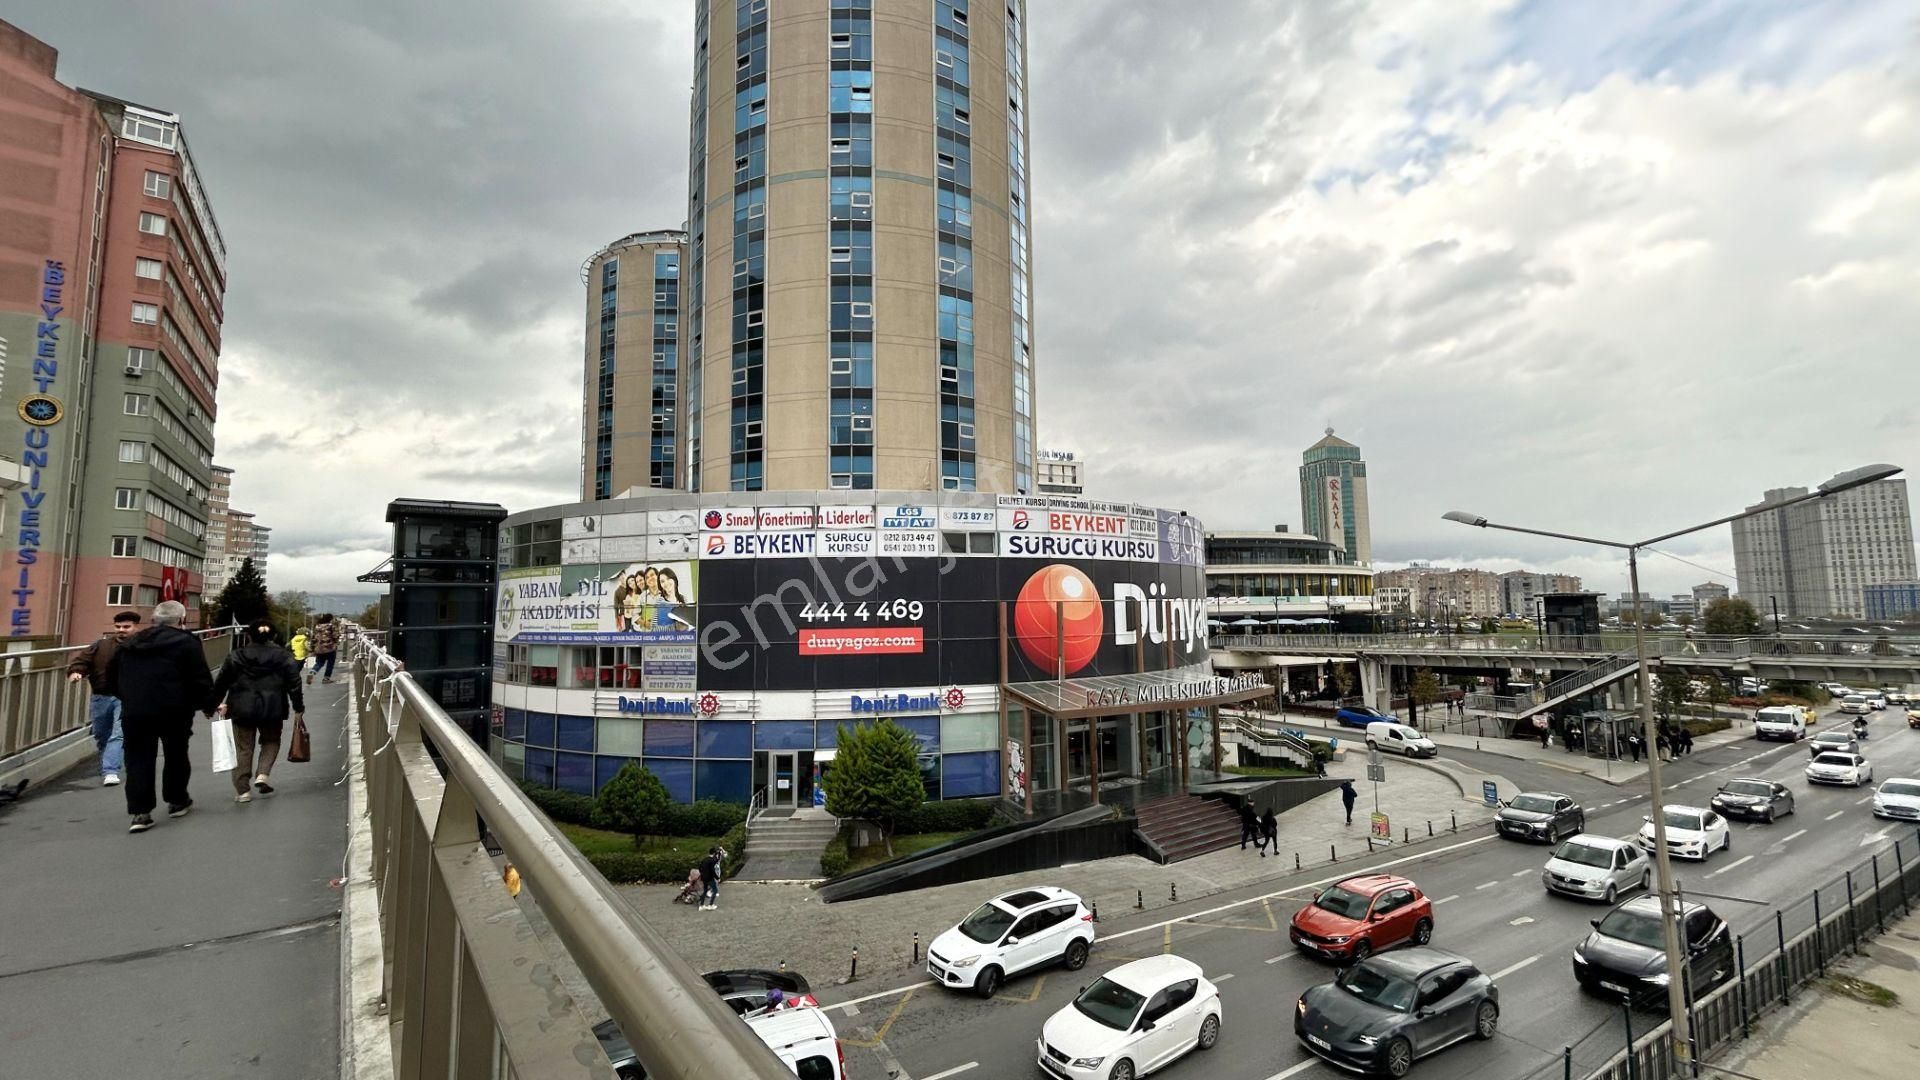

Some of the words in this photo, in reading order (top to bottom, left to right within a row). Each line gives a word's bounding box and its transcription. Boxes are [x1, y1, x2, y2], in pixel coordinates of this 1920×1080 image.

[31, 266, 65, 394] BEYKENT
[1025, 498, 1046, 506] KURSU
[1070, 500, 1089, 510] SCHOOL
[1331, 491, 1340, 529] KAYA
[726, 513, 756, 526] Sınav
[826, 510, 874, 526] Liderleri
[887, 519, 908, 527] TYT
[913, 519, 932, 527] AYT
[952, 513, 968, 521] 873
[970, 513, 981, 521] 87
[983, 512, 994, 521] 87
[1049, 513, 1126, 534] BEYKENT
[734, 533, 816, 554] BEYKENT
[884, 533, 900, 541] 0212
[828, 543, 868, 552] KURSU
[884, 544, 900, 552] 0541
[902, 544, 916, 552] 203
[918, 544, 926, 552] 31
[927, 544, 935, 552] 13
[1009, 535, 1097, 556] SÜRÜCÜ
[1101, 539, 1155, 559] KURSU
[519, 601, 601, 620] AKADEMİSİ
[799, 601, 848, 622] 444
[853, 601, 870, 621] 4
[876, 598, 924, 621] 469
[806, 633, 916, 652] dunyagoz.com
[850, 693, 941, 713] DenizBank
[1086, 687, 1130, 707] KAYA
[1137, 680, 1213, 703] MILLENIUM
[618, 695, 695, 714] DenizBank
